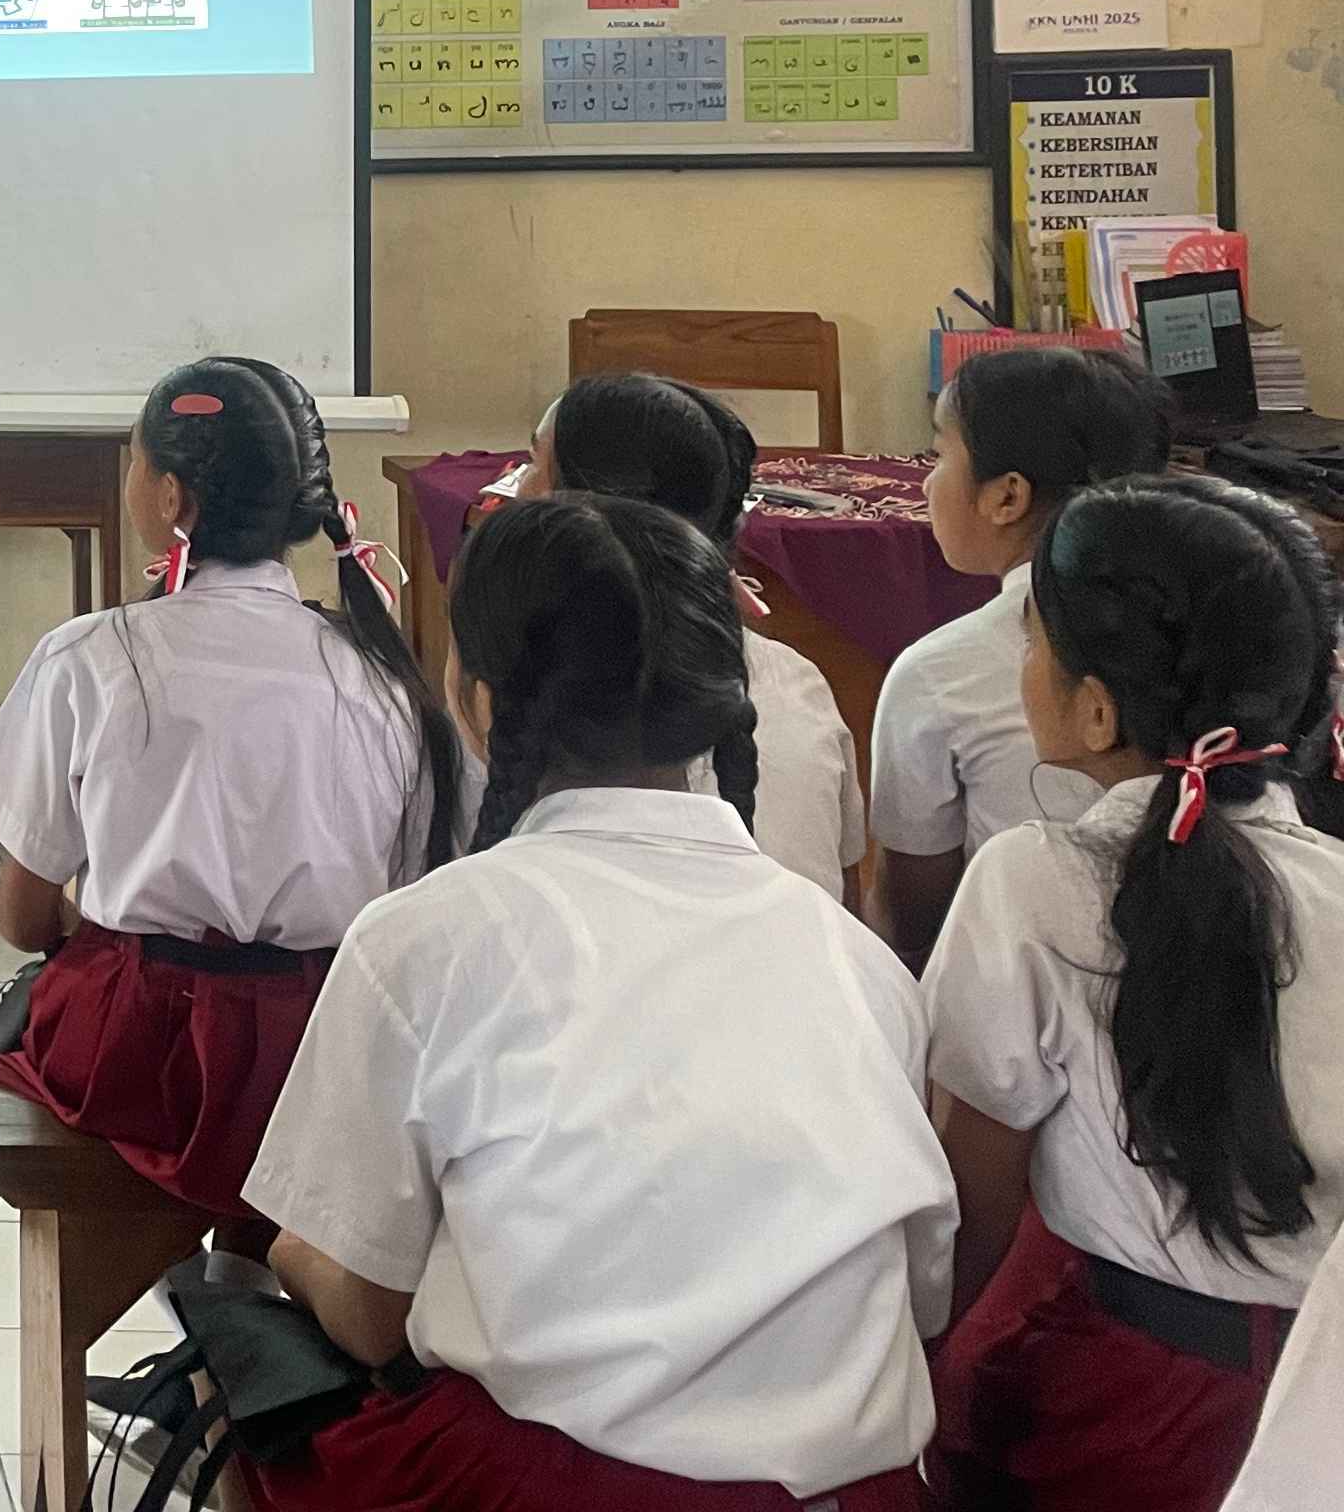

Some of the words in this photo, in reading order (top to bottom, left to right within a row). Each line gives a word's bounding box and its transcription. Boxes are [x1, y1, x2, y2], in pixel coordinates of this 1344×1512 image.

[1104, 12, 1141, 25] 2025
[1084, 75, 1112, 96] 10
[1119, 74, 1138, 95] K
[1040, 110, 1141, 127] KEAMANAN
[1040, 136, 1159, 153] KEBERSIHAN
[1040, 162, 1158, 179] KETERTIBAN
[1040, 188, 1149, 205] KEINDAHAN
